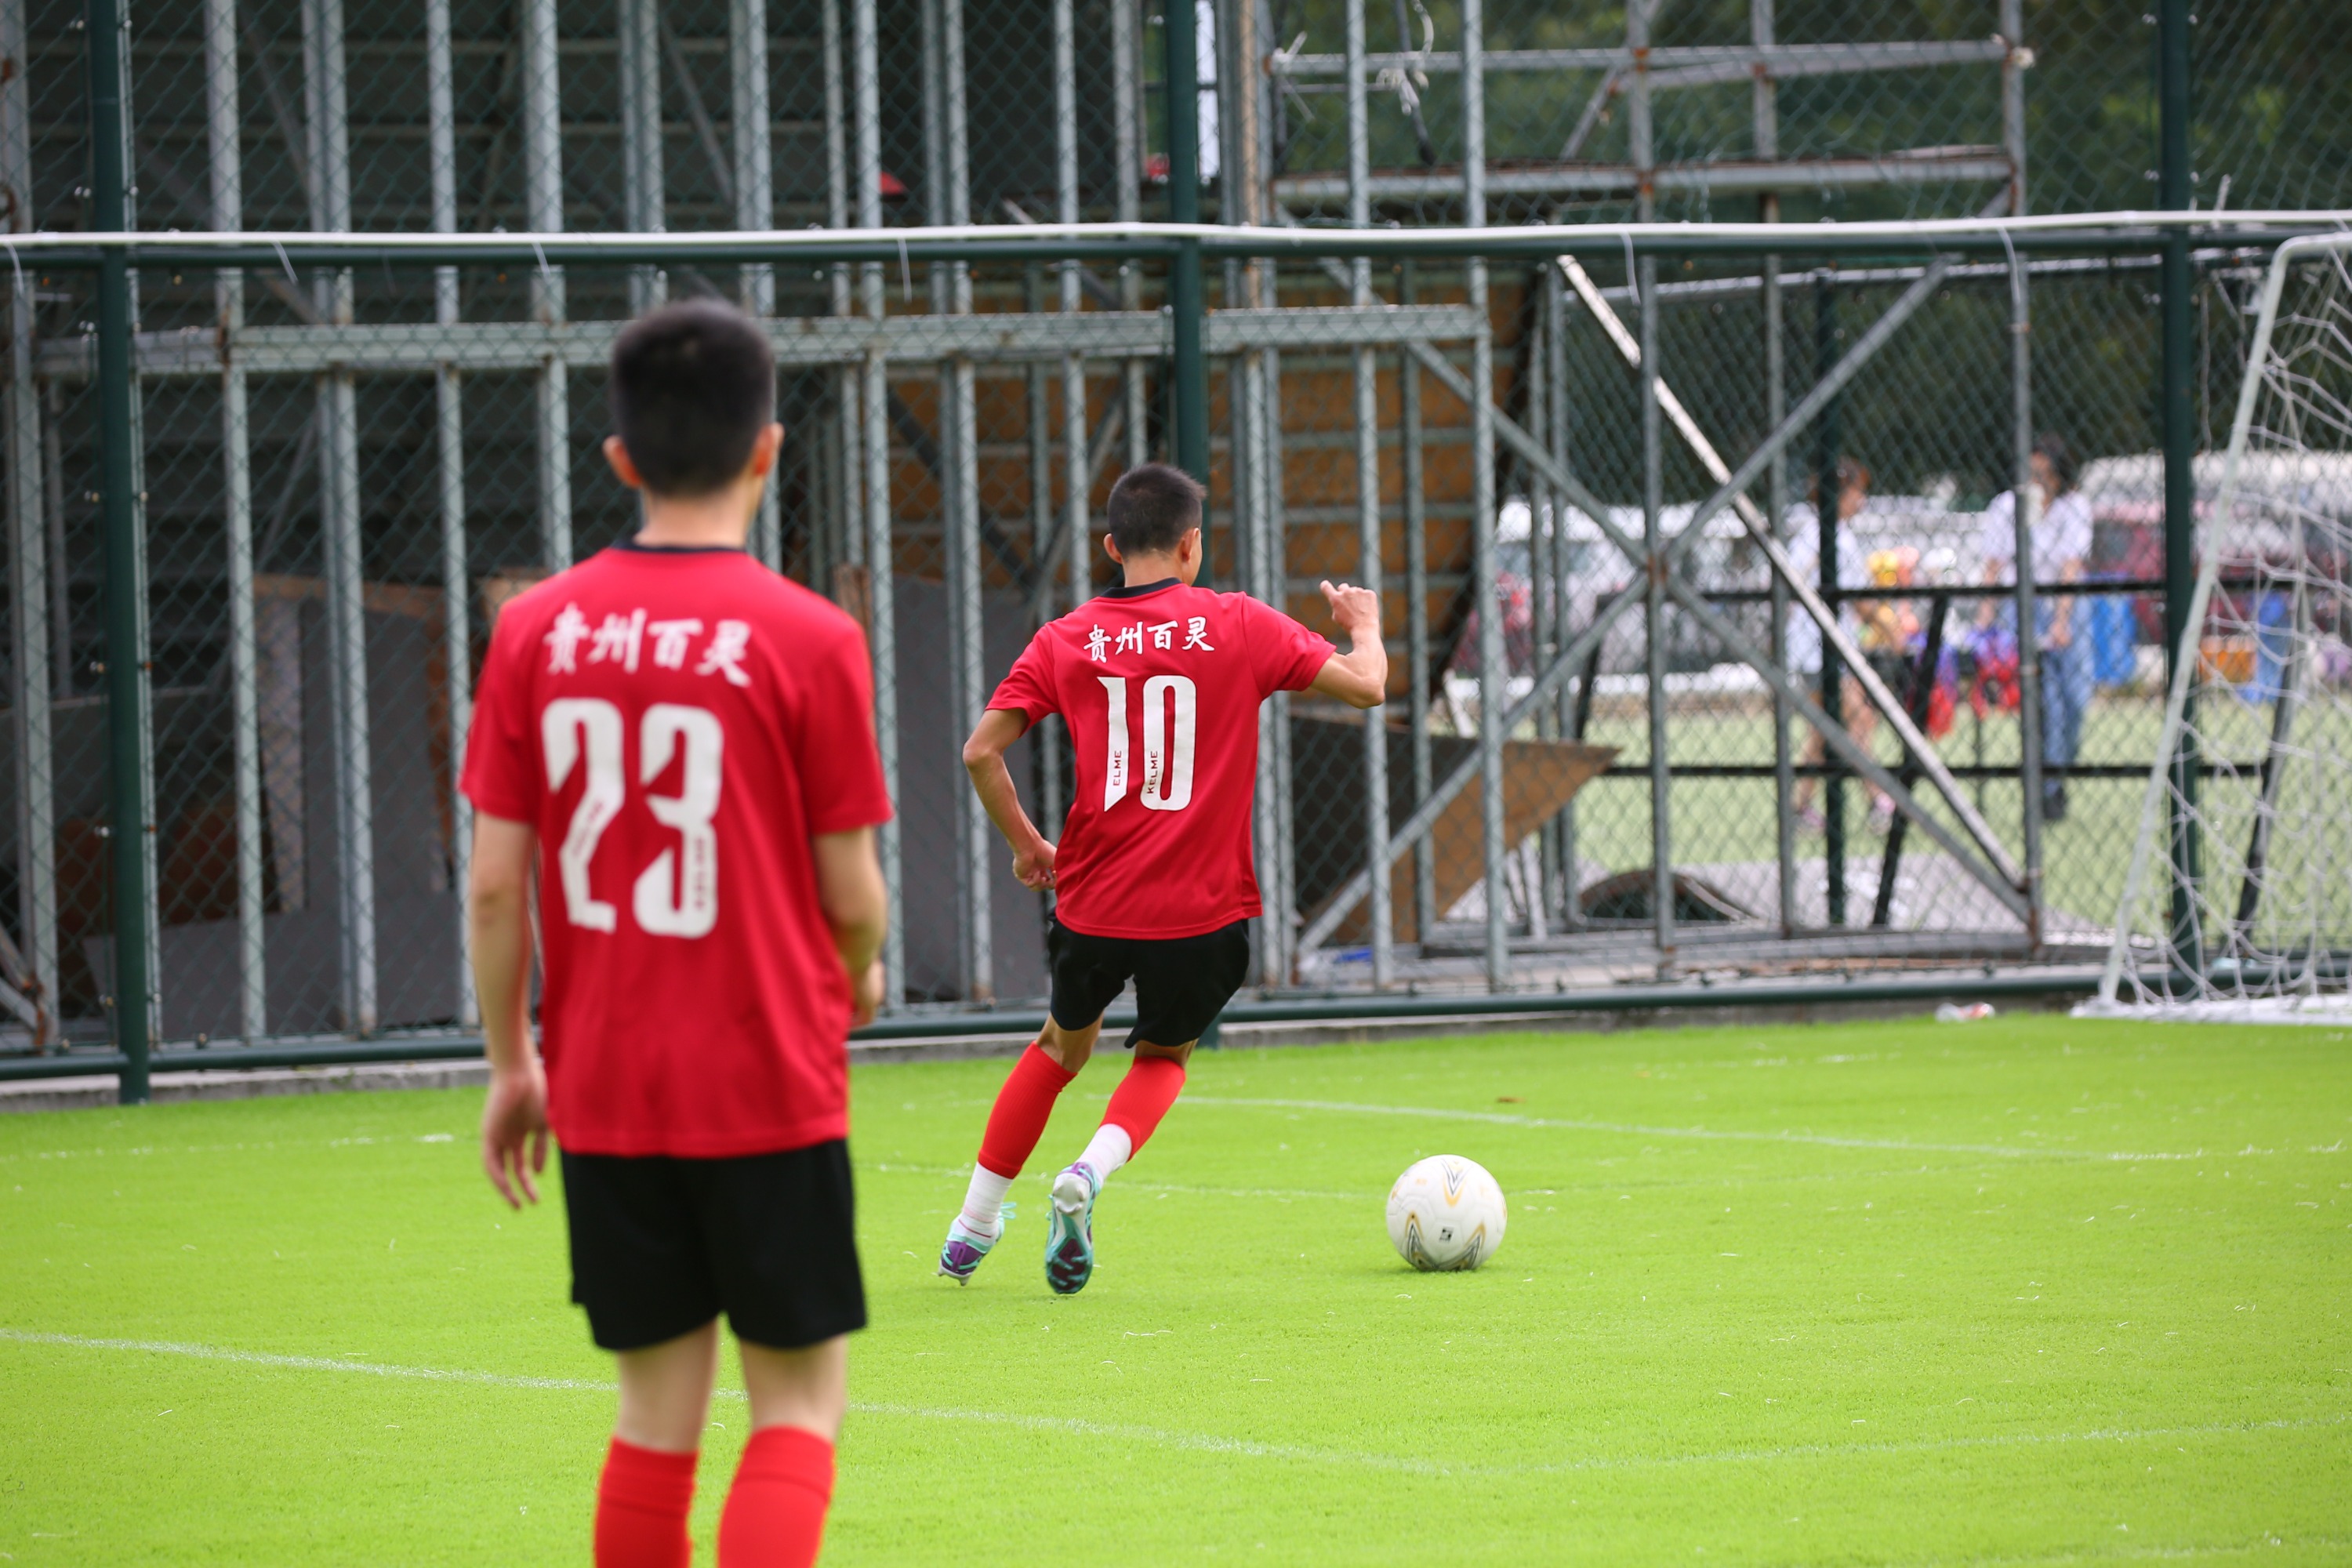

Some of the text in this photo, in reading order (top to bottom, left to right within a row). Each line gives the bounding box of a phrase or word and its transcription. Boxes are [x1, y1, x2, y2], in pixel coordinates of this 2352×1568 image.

[1083, 615, 1215, 663] 贵州百灵
[1096, 674, 1197, 812] 10
[1112, 750, 1123, 786] ELME
[1146, 750, 1159, 794] KELME
[540, 696, 725, 940] 23
